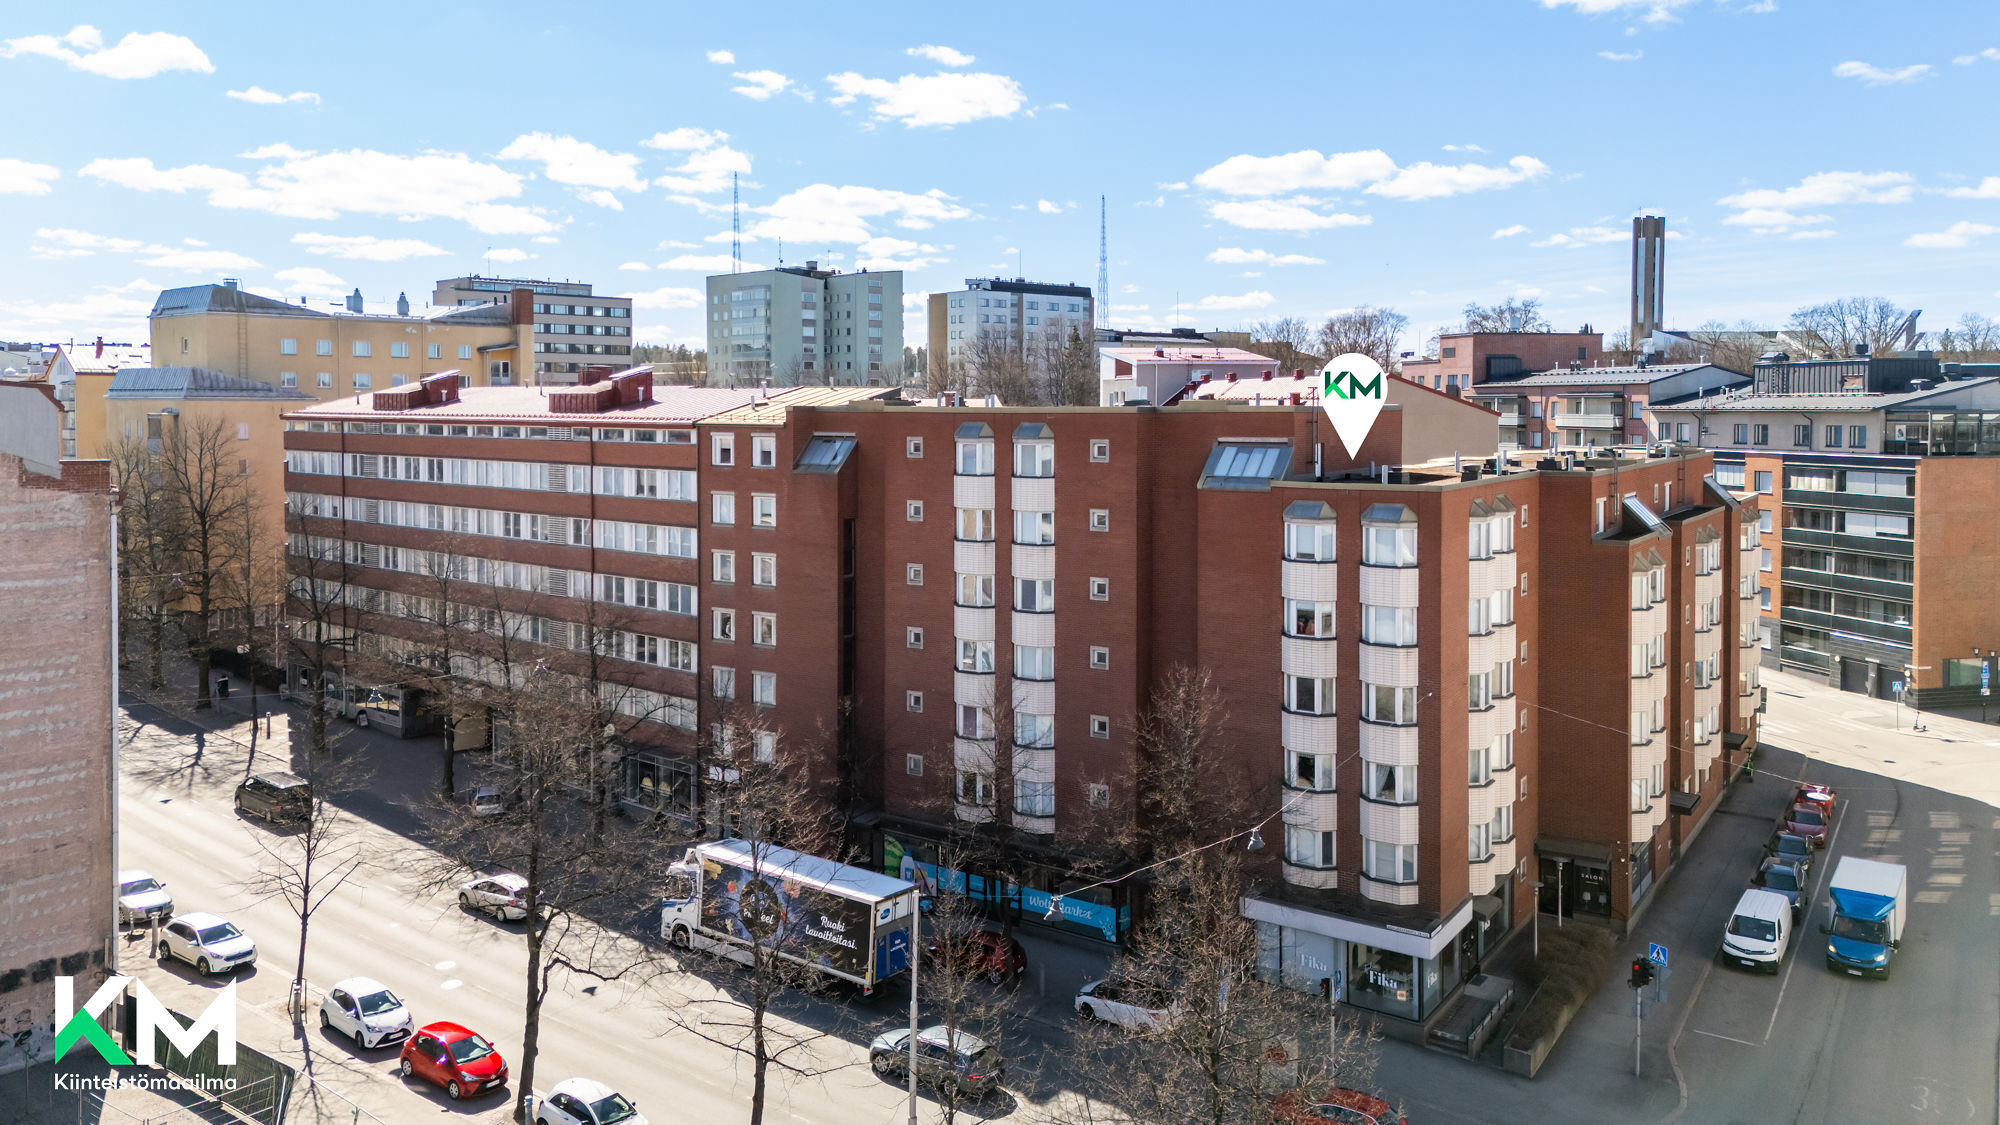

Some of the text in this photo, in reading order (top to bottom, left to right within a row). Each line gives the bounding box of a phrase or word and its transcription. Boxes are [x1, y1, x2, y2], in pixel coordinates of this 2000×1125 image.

[820, 916, 846, 932] Ruoki
[805, 924, 857, 950] tavoitteitasi.
[1301, 953, 1327, 971] Fika
[1369, 970, 1398, 989] Fika
